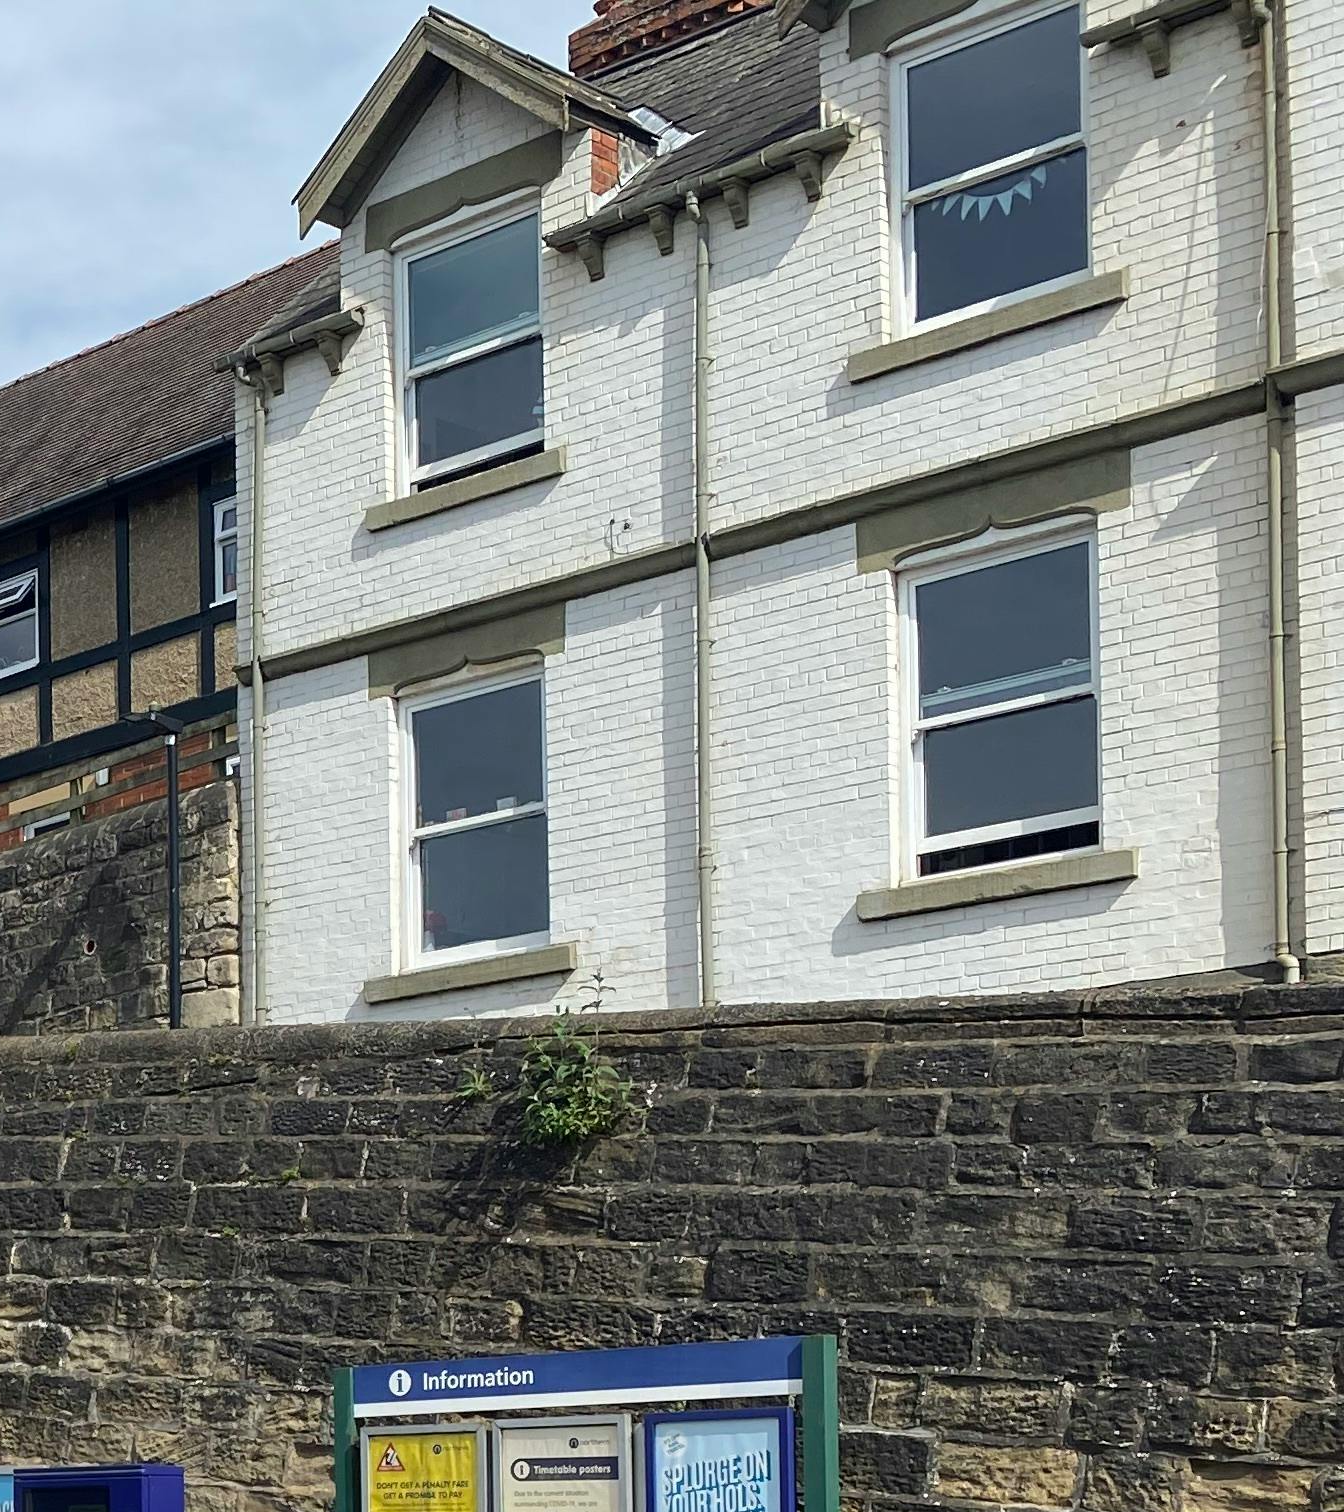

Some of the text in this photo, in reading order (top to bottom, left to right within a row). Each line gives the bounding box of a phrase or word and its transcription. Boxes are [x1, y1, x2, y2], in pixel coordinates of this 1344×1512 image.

[423, 1366, 534, 1391] Information
[533, 1464, 577, 1475] Timetable
[578, 1465, 611, 1477] posters
[664, 1450, 771, 1496] SPLURGE ON
